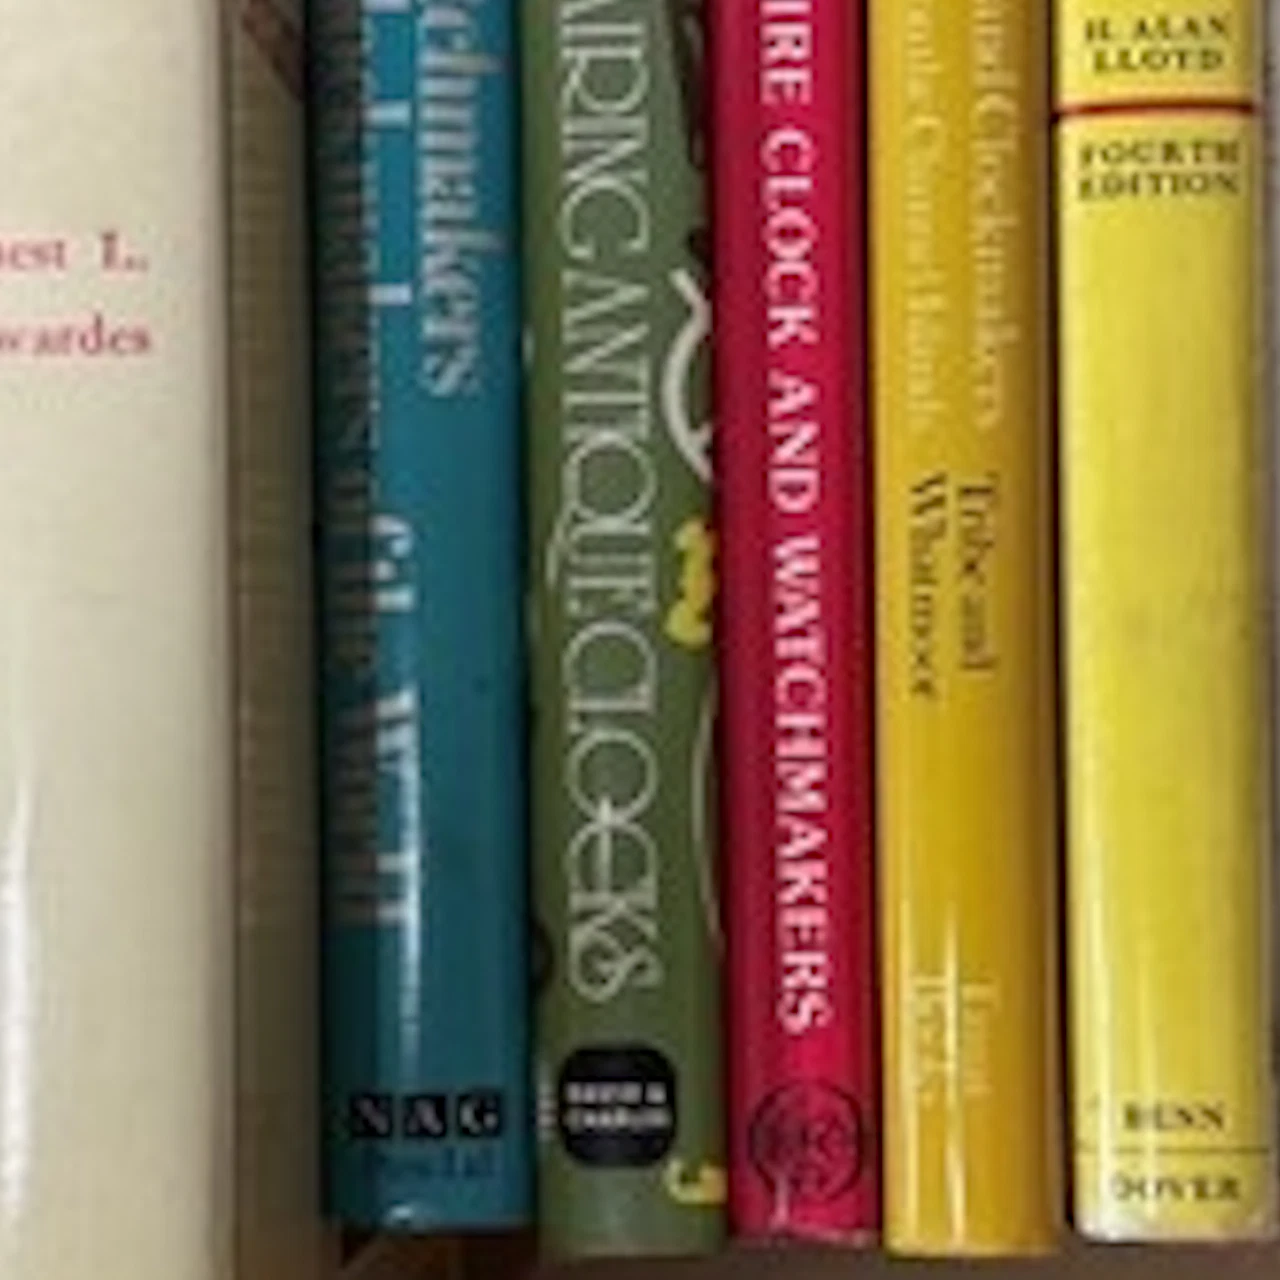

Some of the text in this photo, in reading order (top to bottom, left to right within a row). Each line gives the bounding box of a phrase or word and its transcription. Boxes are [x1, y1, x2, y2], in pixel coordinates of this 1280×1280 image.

[1093, 47, 1224, 76] LLOYD
[1133, 13, 1229, 40] ALAN
[1079, 141, 1240, 169] FOURTH
[1079, 172, 1240, 201] EDITION
[100, 231, 149, 274] L.
[761, 128, 820, 349] CLOCK
[971, 96, 1019, 430] Clockmakers
[547, 268, 658, 613] ANTIQUE
[766, 373, 820, 514] AND
[959, 593, 999, 673] and
[561, 622, 664, 1002] CLOCKS
[773, 535, 833, 1035] WATCHMAKERS
[1113, 1174, 1242, 1202] DOVER
